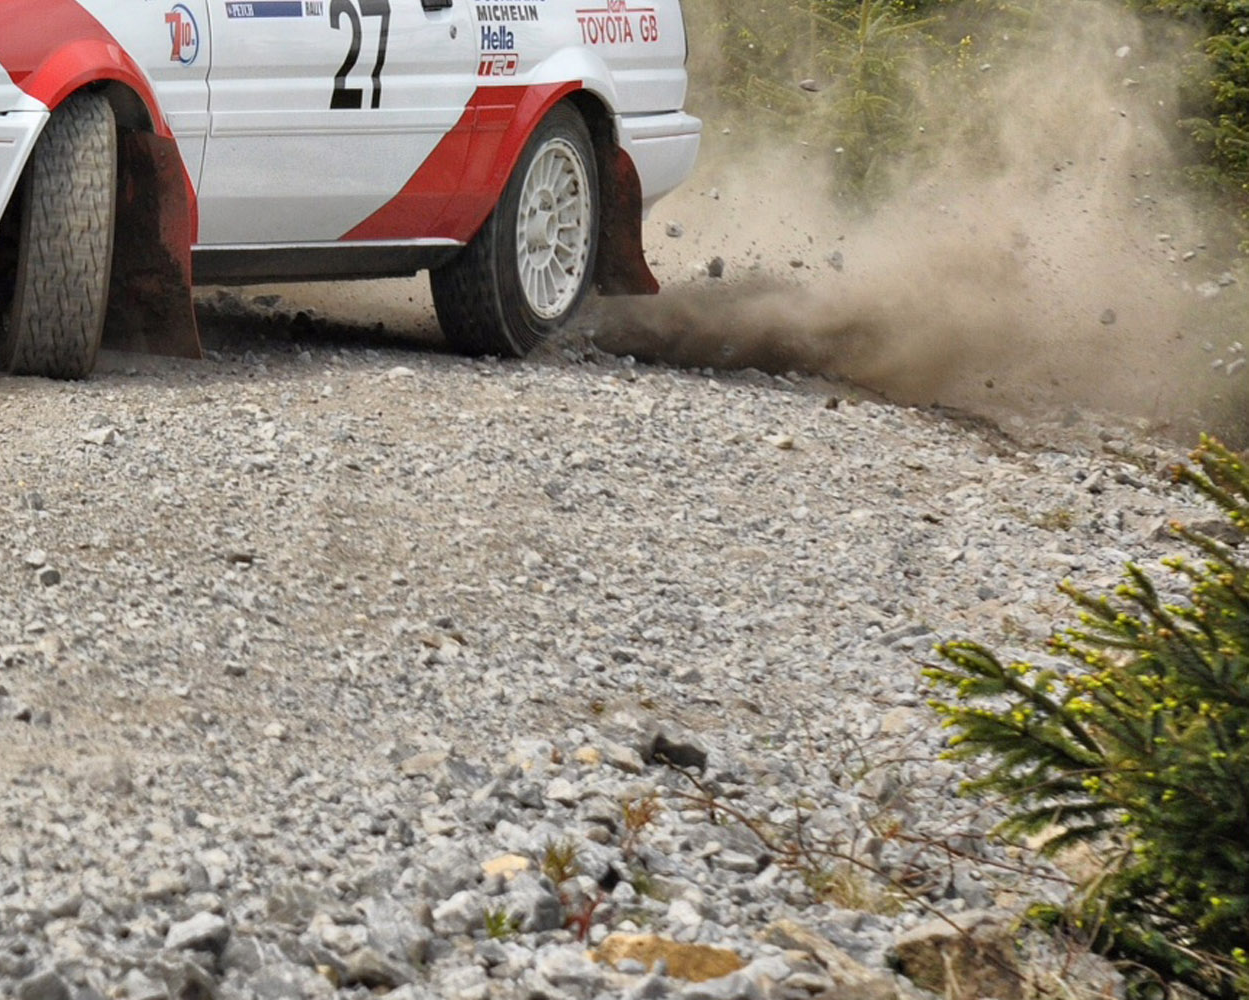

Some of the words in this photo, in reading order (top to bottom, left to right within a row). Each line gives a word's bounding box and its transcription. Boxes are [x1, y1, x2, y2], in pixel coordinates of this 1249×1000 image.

[305, 1, 323, 16] RALLY
[476, 5, 539, 21] MICHELIN
[481, 25, 515, 50] Hella
[577, 15, 634, 45] TOYOTA
[639, 14, 659, 43] GB
